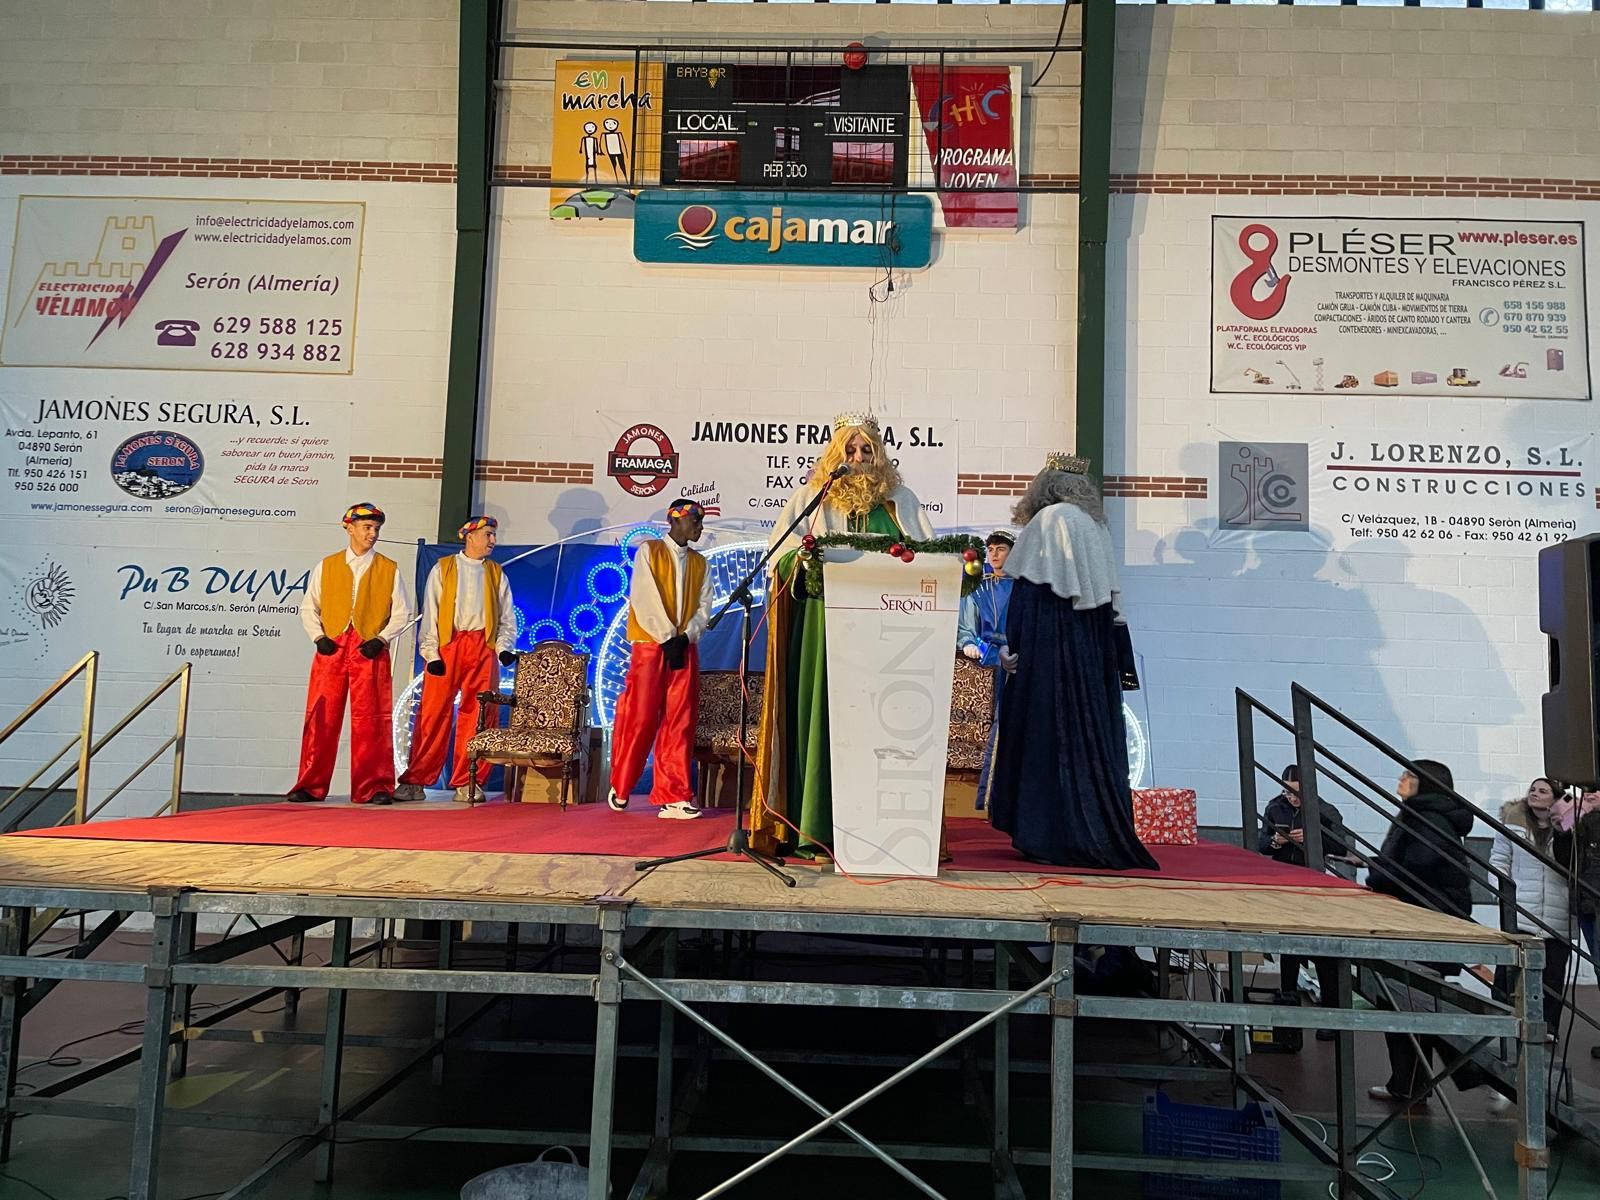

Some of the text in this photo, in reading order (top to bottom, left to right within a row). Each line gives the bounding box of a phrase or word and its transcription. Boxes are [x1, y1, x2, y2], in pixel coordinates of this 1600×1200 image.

[573, 69, 609, 89] en
[562, 77, 652, 110] marcha
[677, 114, 738, 131] LOCAL
[833, 117, 896, 133] VISITANTE
[763, 163, 808, 178] PERODO
[944, 172, 999, 189] JOVEN
[196, 215, 355, 230] info@electricidadyelamos.com
[724, 206, 893, 252] cajamar
[194, 232, 353, 246] www.electricidadyelamos.com
[1289, 228, 1457, 255] PLÉSER
[1457, 231, 1578, 246] www.pleser.es
[1289, 256, 1567, 277] DESMONTES Y ELEVACIONES
[185, 272, 340, 296] Serón (Almería)
[1452, 278, 1567, 289] FRANCISCO PÉREZ S.L.
[1336, 291, 1374, 300] TRANSPORTES
[1380, 292, 1406, 302] ALQUILER
[1416, 293, 1450, 303] MAQUINARIA
[1317, 302, 1339, 311] CAMIÓN
[1360, 302, 1381, 311] CAMIÓN
[1382, 304, 1397, 312] CUBA
[1402, 304, 1438, 312] MOVIMIENTOS
[1448, 305, 1468, 313] TIERRA
[213, 316, 343, 336] 629 588 125
[1314, 314, 1362, 322] COMPACTACIONES
[1388, 315, 1396, 323] DE
[1397, 315, 1415, 323] CANTO
[1417, 315, 1439, 324] RODADO
[1446, 316, 1471, 324] CANTERA
[1216, 325, 1317, 334] PLATAFORMAS ELEVADORAS
[1338, 325, 1382, 334] CONTENEDORES
[1253, 334, 1300, 342] ECOLÓGICOS
[210, 341, 341, 362] 628 934 882
[1246, 343, 1293, 351] ECOLÓGICOS
[33, 399, 310, 427] JAMONES SEGURA, S.L.
[4, 428, 98, 440] Avda. Lepanto, 61
[246, 435, 288, 445] recuerde:
[290, 437, 299, 445] si
[301, 437, 329, 447] quiere
[622, 427, 664, 444] JAMONES
[691, 421, 944, 450] JAMONES FRAA, S.L.
[18, 441, 83, 453] 04890 Serón
[221, 448, 336, 461] saborear un buen jamón,
[25, 455, 72, 467] (Almería)
[766, 456, 822, 469] TLF. 95
[1330, 442, 1353, 461] J.
[1370, 443, 1512, 468] LORENZO,
[245, 462, 309, 472] pida la marca
[615, 457, 673, 470] FRAMAGA
[24, 468, 43, 478] 950
[46, 469, 66, 479] 426
[70, 469, 87, 479] 151
[234, 475, 275, 485] SEGURA
[277, 477, 289, 485] de
[14, 481, 79, 492] 950 526 000
[766, 475, 793, 488] FAX
[1333, 476, 1585, 497] CONSTRUCCIONES
[680, 481, 716, 498] Calidad
[31, 503, 297, 518] www.jamonessegura.com seron@jamonesegura.com
[1341, 513, 1354, 524] C/
[1358, 513, 1420, 526] Velázquez,
[1424, 515, 1438, 525] 1B
[1449, 516, 1485, 526] 04890
[1525, 518, 1576, 531] (Almería)
[1350, 527, 1568, 542] Telf: 950 42 62 06 Fax: 950 42 61 92
[200, 566, 311, 604] DUNA
[229, 603, 255, 613] Serón
[257, 604, 299, 616] (Almería)
[142, 622, 282, 637] Tu lugar de marcha en Serón
[174, 644, 241, 659] Os esperamos!
